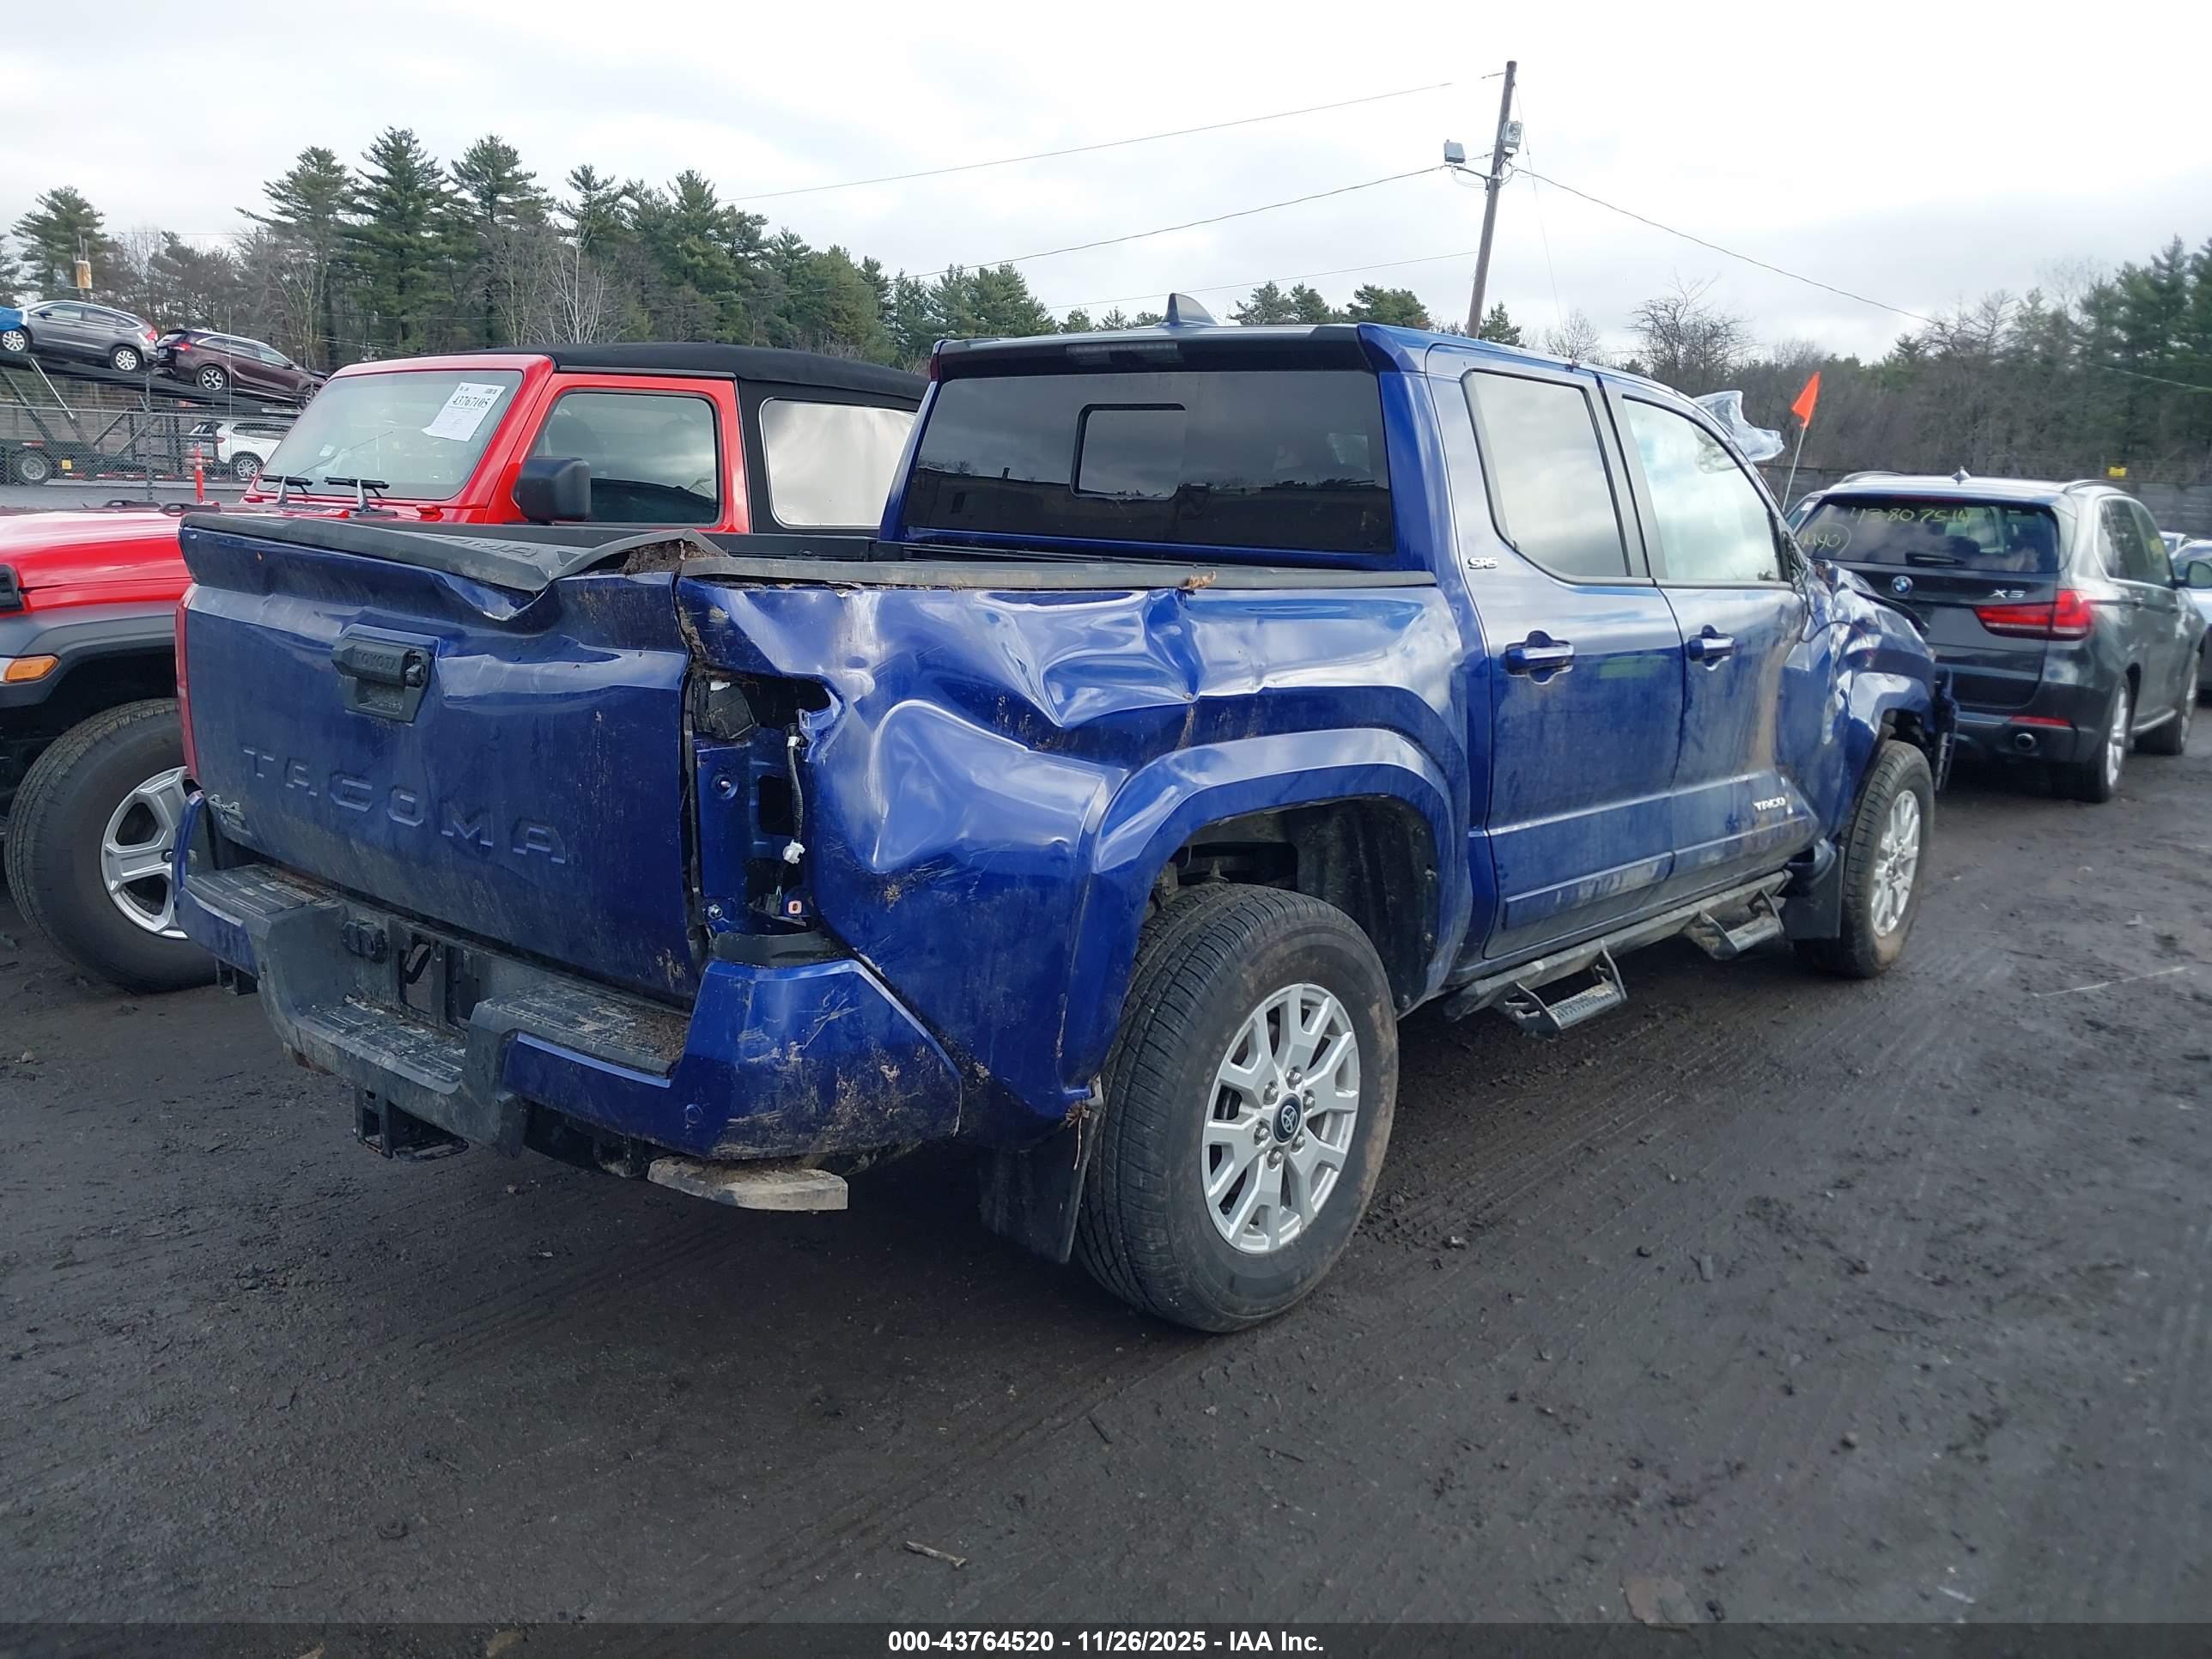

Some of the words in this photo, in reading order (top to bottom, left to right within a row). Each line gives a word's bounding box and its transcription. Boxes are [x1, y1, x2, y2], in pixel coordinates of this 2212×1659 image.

[1990, 589, 2027, 599] X5
[355, 650, 399, 672] TOYOTA
[241, 742, 568, 865] TACOMA
